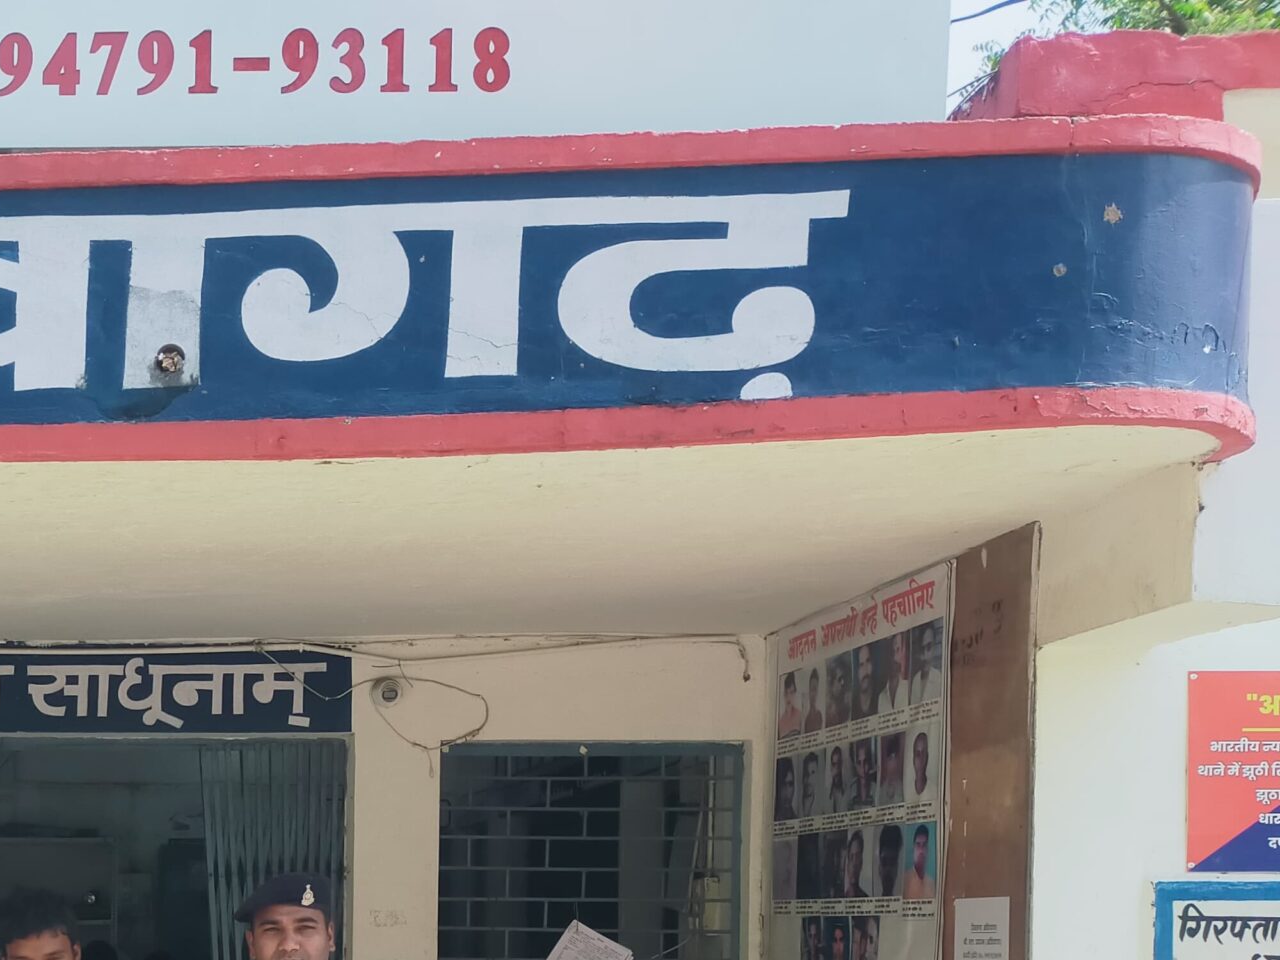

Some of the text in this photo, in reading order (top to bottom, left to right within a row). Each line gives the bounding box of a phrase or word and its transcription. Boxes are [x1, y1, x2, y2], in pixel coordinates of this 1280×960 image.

[27, 657, 328, 728] साधूनाम्
[1198, 762, 1225, 776] थाने
[1227, 762, 1241, 776] में
